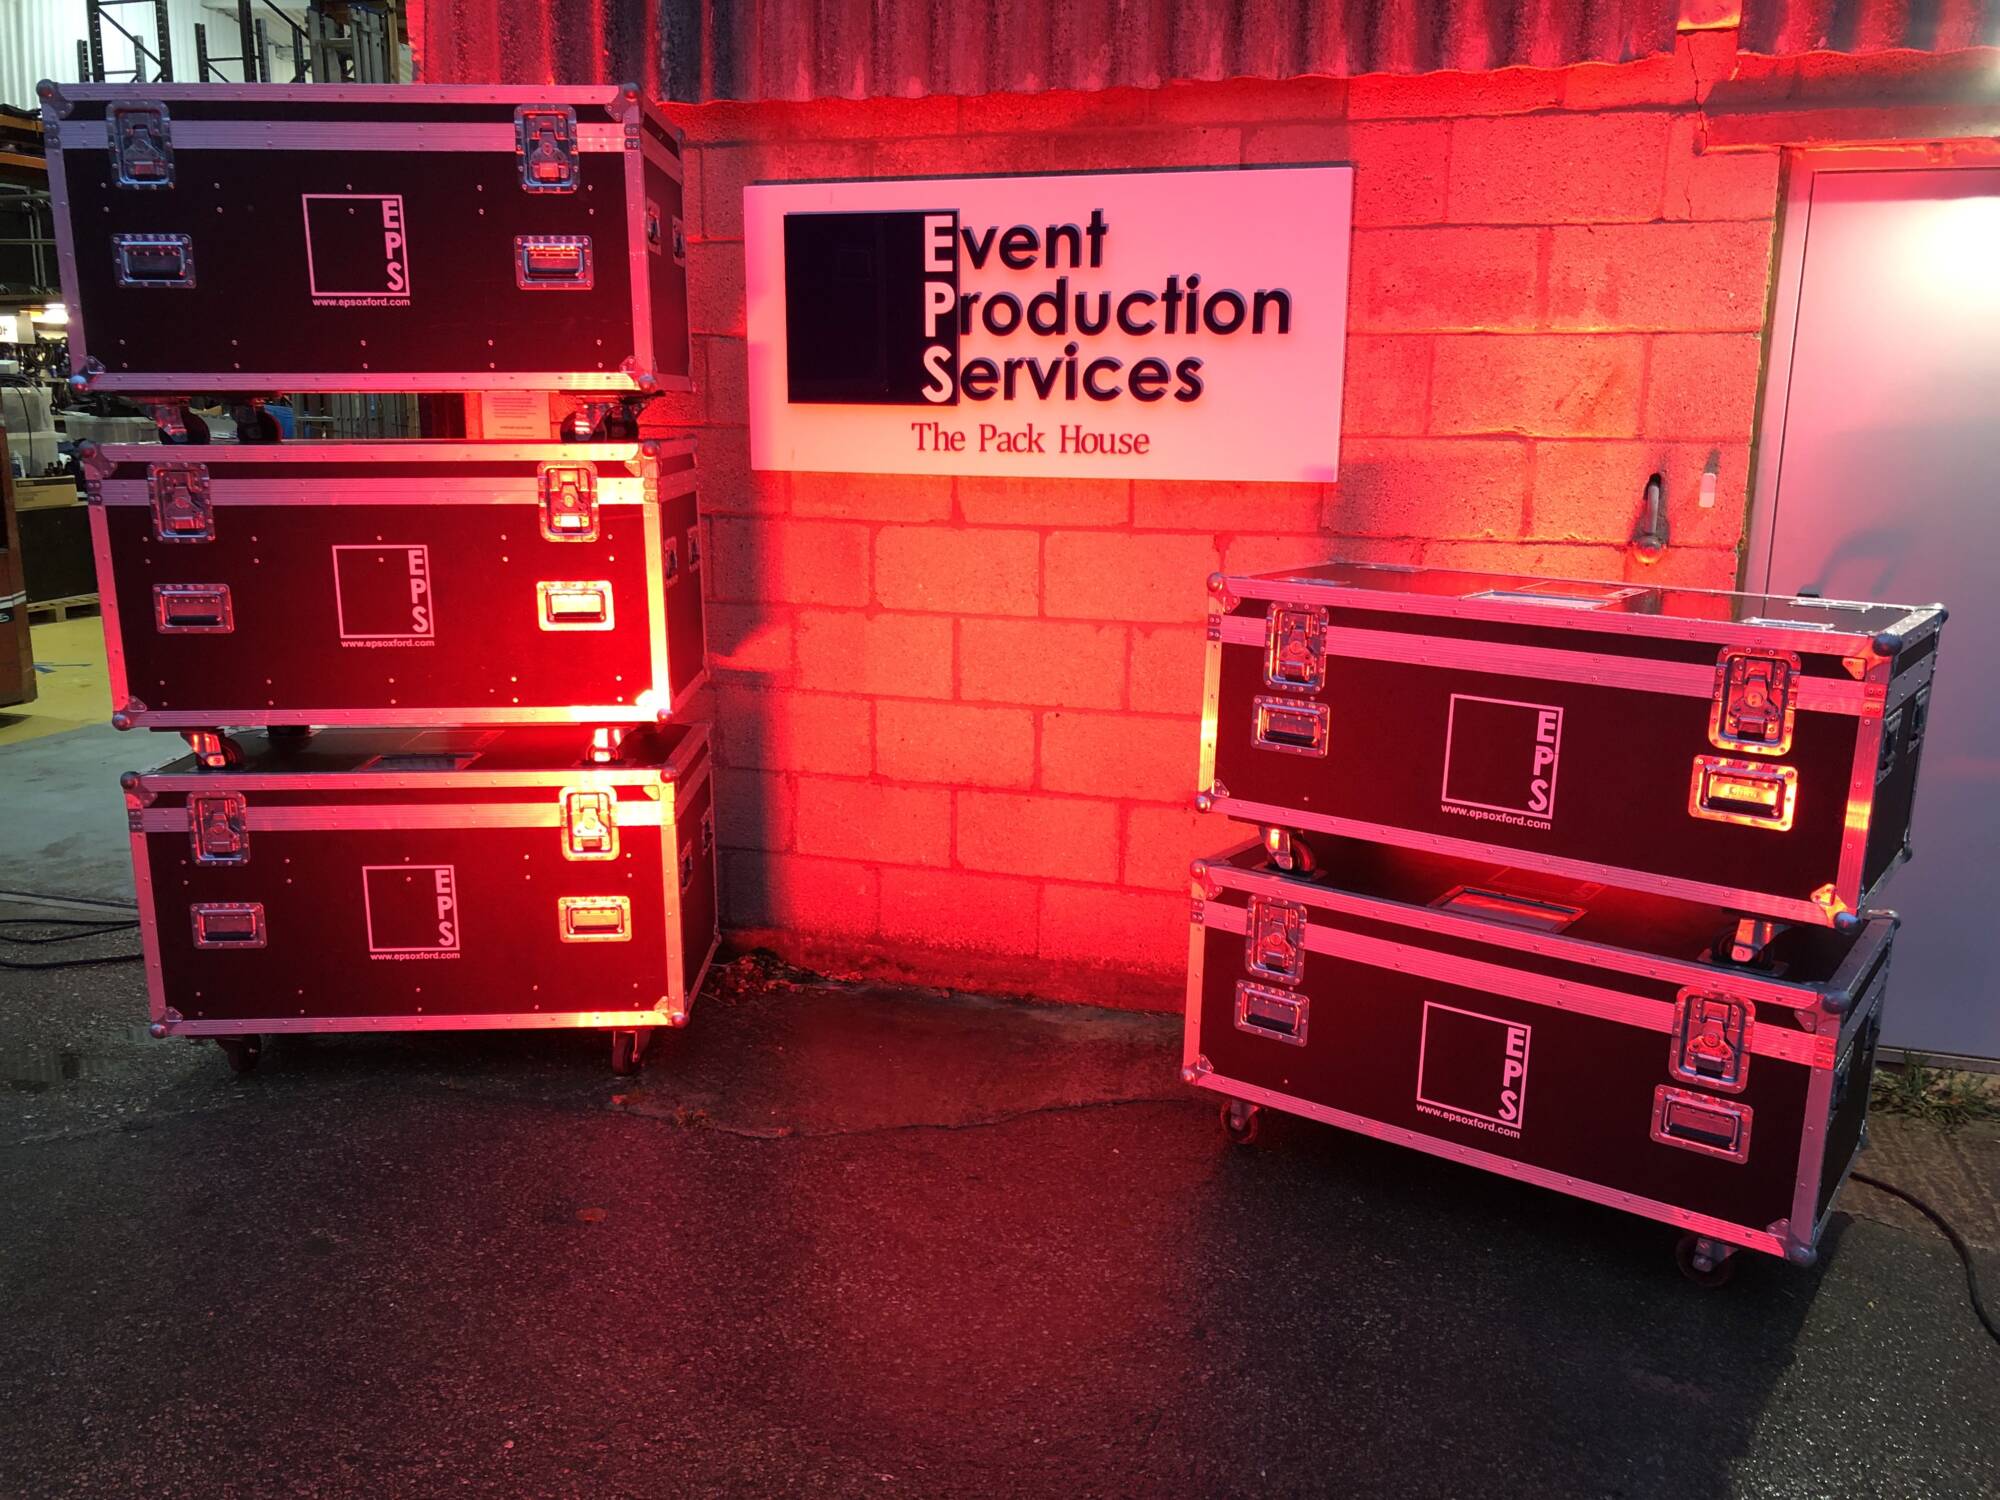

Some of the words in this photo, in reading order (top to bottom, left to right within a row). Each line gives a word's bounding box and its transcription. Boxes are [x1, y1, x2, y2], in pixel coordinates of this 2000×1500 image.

[382, 200, 405, 292] EPS
[923, 208, 1109, 271] Event
[312, 298, 411, 308] www.epsoxford.com
[923, 273, 1293, 338] Production
[921, 341, 1205, 403] Services
[911, 421, 966, 452] The
[978, 423, 1046, 454] Pack
[1059, 424, 1150, 455] House
[407, 549, 429, 633] EPS
[341, 639, 435, 649] www.epsoxford.com
[1527, 710, 1557, 812] EPS
[1441, 804, 1551, 830] www.epsoxford.com
[434, 869, 455, 947] EPS
[370, 952, 461, 961] www.epsoxford.com
[1498, 1026, 1526, 1121] EPS
[1416, 1103, 1521, 1139] www.epsoxford.com
